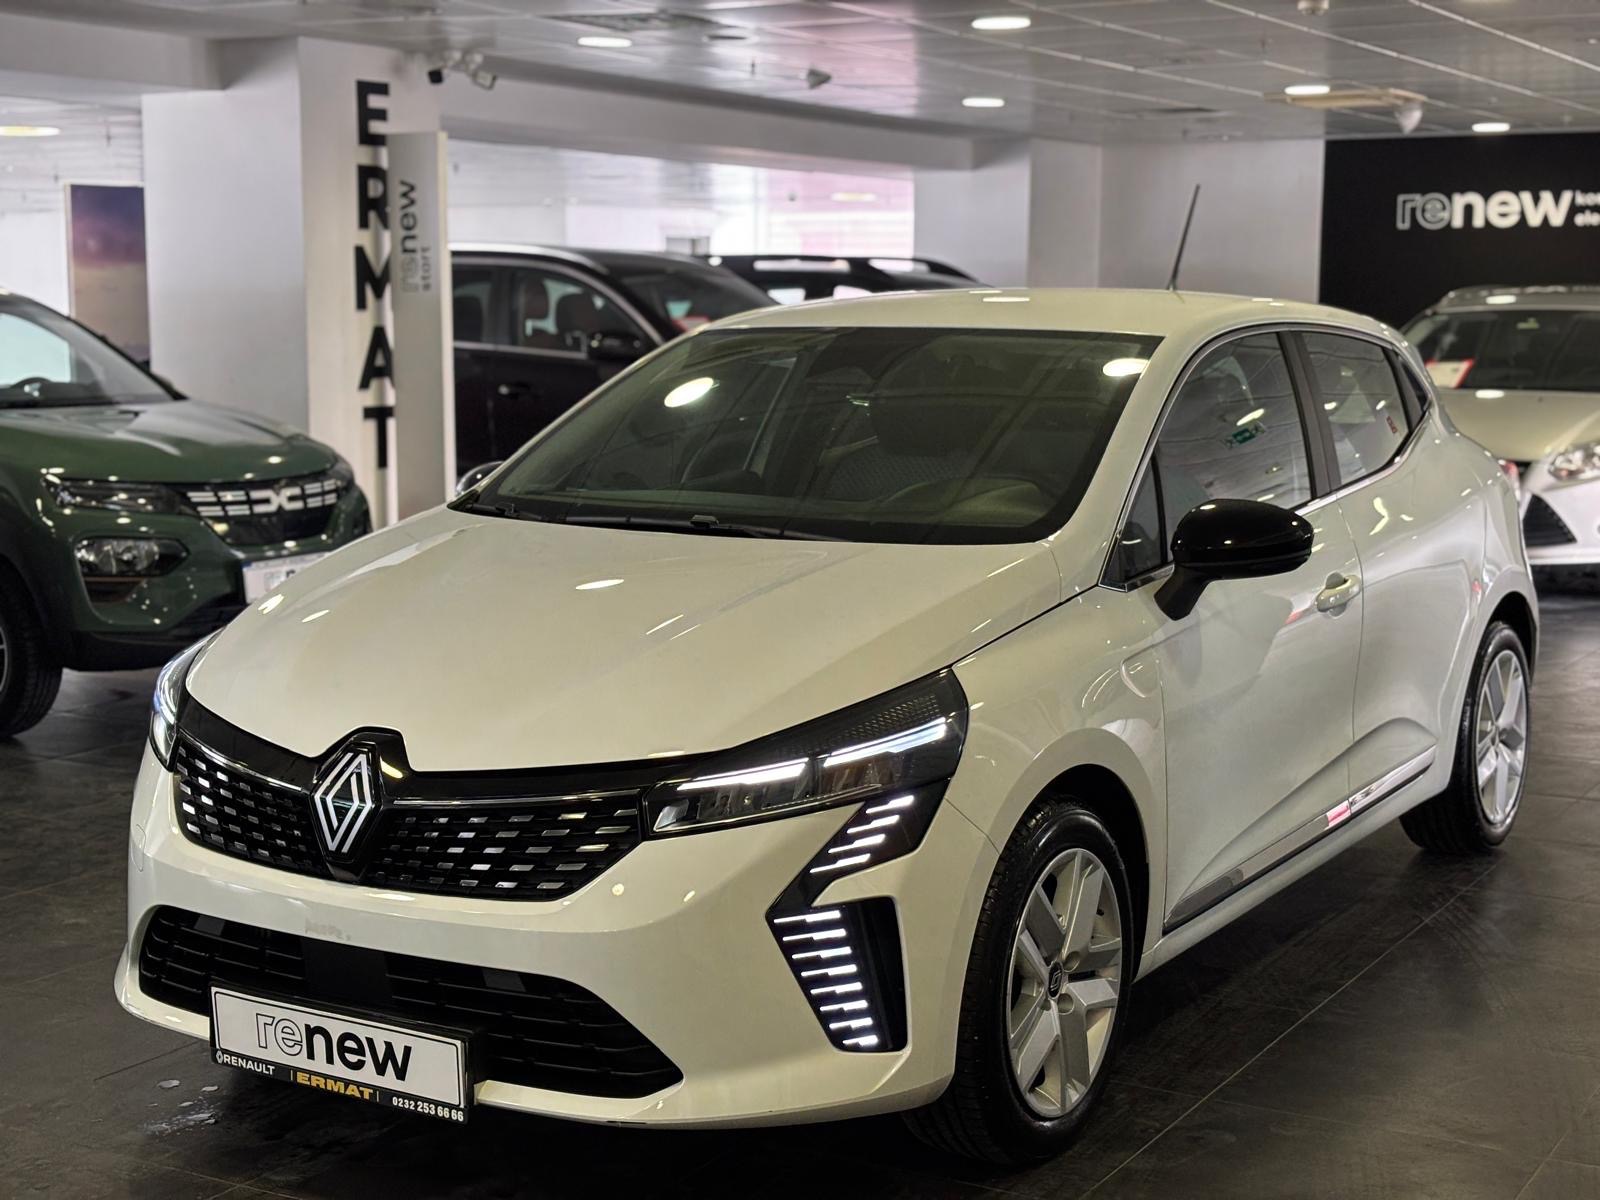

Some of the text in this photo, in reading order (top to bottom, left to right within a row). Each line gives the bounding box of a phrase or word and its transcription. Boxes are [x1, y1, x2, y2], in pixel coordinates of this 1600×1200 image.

[1396, 189, 1574, 231] renew
[354, 79, 396, 468] ERMAT
[255, 1012, 413, 1081] renew
[223, 1054, 276, 1075] RENAULT
[296, 1071, 374, 1100] ERMAT
[392, 1096, 415, 1110] 0232
[417, 1101, 436, 1115] 253
